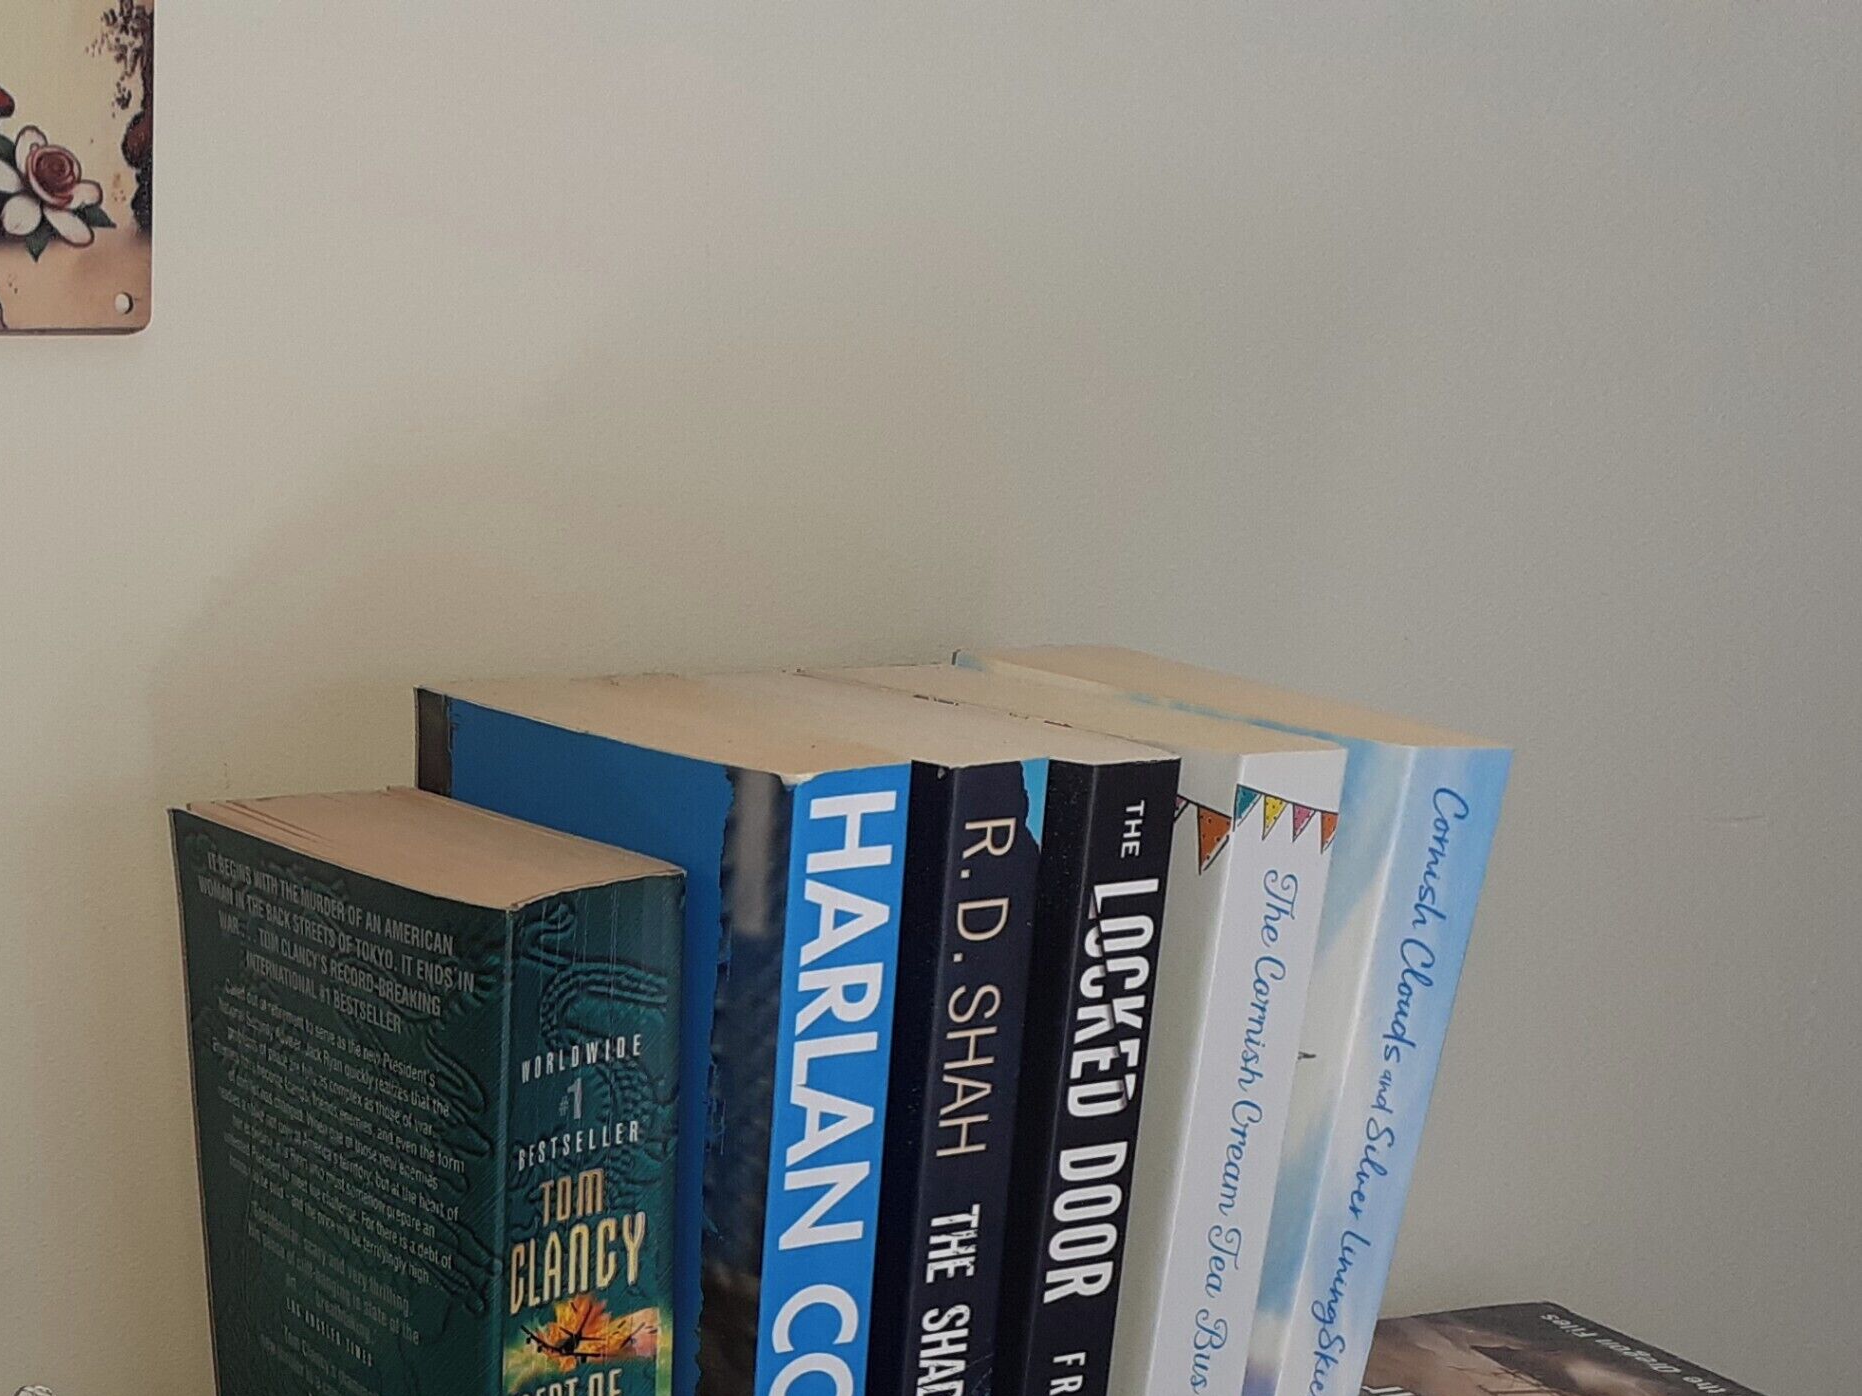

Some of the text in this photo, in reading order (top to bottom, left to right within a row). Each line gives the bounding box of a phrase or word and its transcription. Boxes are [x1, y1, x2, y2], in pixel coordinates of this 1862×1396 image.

[1412, 787, 1468, 927] Cornish
[198, 875, 233, 903] WOMAN
[247, 895, 264, 917] THE
[265, 903, 290, 928] BACK
[293, 915, 335, 948] STREETS
[338, 931, 353, 954] OF
[355, 938, 397, 970] TOKYO.
[401, 954, 412, 976] IT
[417, 956, 452, 990] ENDS
[458, 969, 474, 994] IN
[253, 870, 277, 894] WITH
[279, 879, 298, 903] THE
[300, 889, 344, 921] MURDER
[348, 905, 362, 927] OF
[365, 912, 381, 933] AN
[384, 915, 452, 959] AMERICAN
[245, 951, 316, 998] INTERNATIONAL
[333, 989, 401, 1034] BESTSELLER
[258, 928, 279, 952] TOM
[281, 938, 326, 973] CLANCY'S
[329, 957, 441, 1019] RECORD-BREAKING
[935, 816, 1016, 1157] R. D. SHAH
[1383, 937, 1436, 1064] Clouds
[520, 1033, 642, 1084] WORLDWIDE
[778, 790, 897, 1251] HARLAN
[1043, 799, 1159, 1304] THE LOCKED DOOR
[383, 1052, 435, 1090] President's
[410, 1088, 430, 1112] that
[432, 1097, 449, 1119] the
[1364, 1069, 1392, 1114] and
[419, 1143, 434, 1163] the
[518, 1119, 640, 1172] BESTSELLER
[1191, 869, 1299, 1395] The Cornish Cream Tea Bus
[1349, 1115, 1395, 1220] Silver
[447, 1202, 458, 1222] of
[538, 1167, 606, 1227] TOM
[441, 1250, 451, 1271] of
[509, 1210, 648, 1315] CLANCY
[926, 1204, 980, 1284] THE
[1311, 1230, 1371, 1325] Lining
[1540, 1312, 1599, 1339] Files
[1682, 1375, 1727, 1395] the
